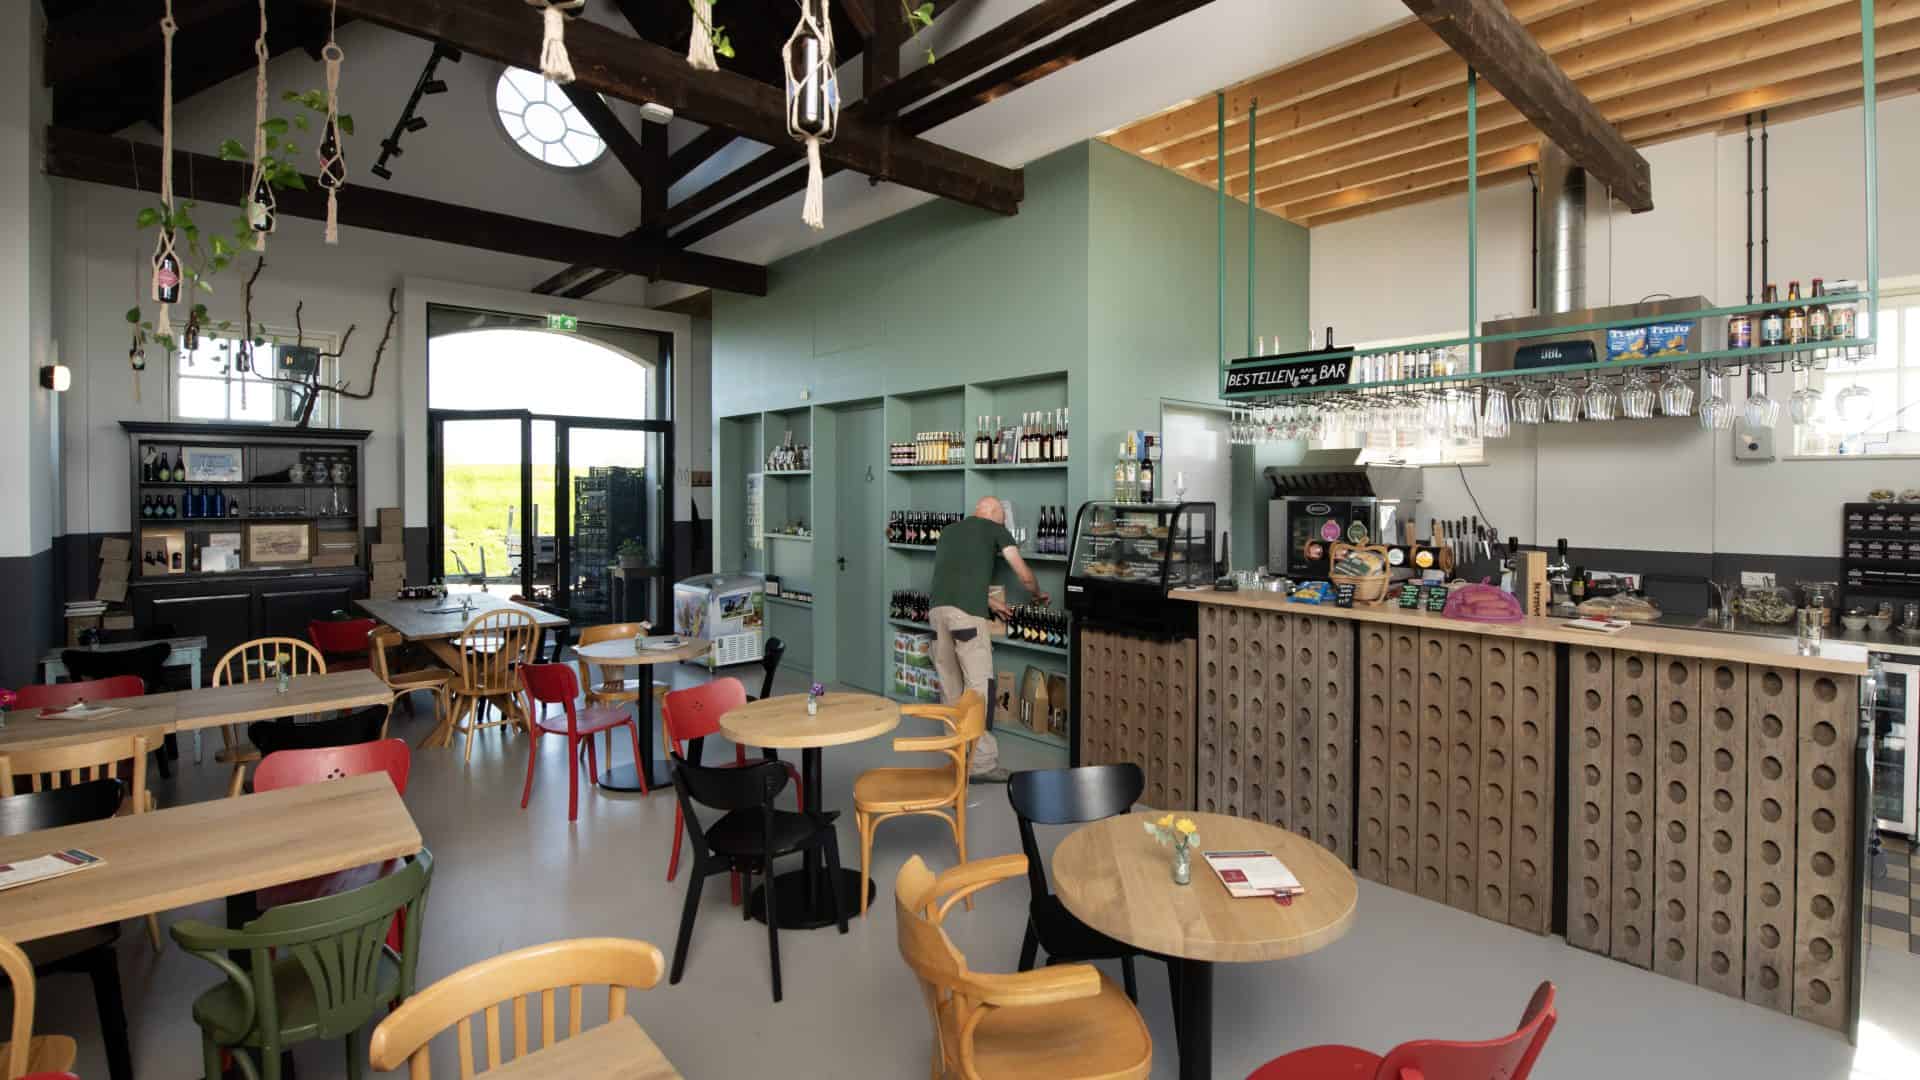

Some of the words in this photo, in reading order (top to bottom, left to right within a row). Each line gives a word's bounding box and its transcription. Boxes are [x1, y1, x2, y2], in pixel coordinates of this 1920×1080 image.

[1651, 324, 1689, 334] Trafo
[1228, 368, 1296, 386] BESTELLEN
[1320, 363, 1346, 380] BAR
